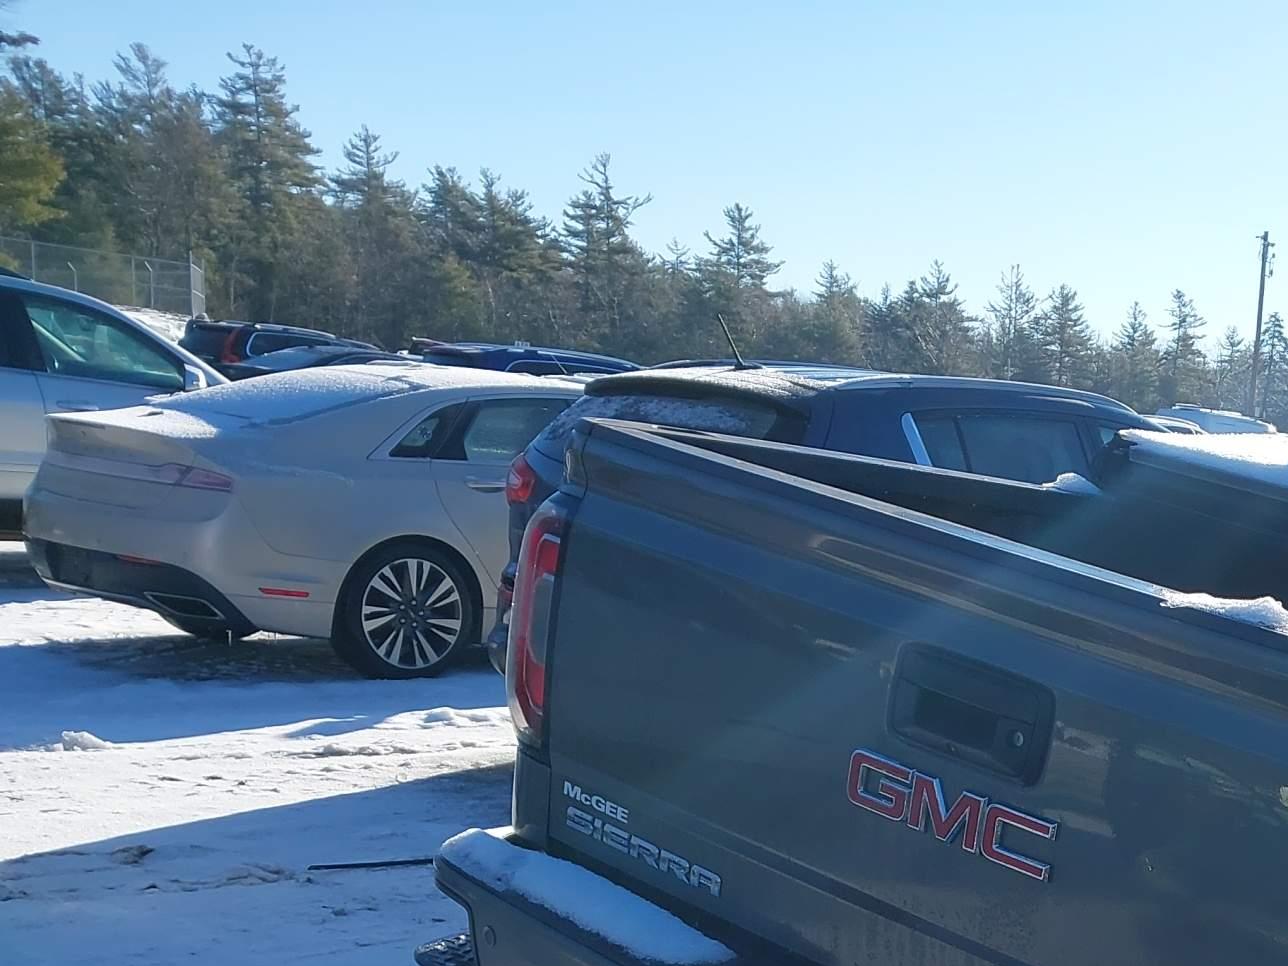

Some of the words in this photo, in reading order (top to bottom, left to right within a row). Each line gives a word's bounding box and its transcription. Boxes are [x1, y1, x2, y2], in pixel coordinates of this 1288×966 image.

[563, 779, 629, 824] McGEE
[847, 747, 1058, 882] GMC
[566, 805, 723, 897] SIERRA
